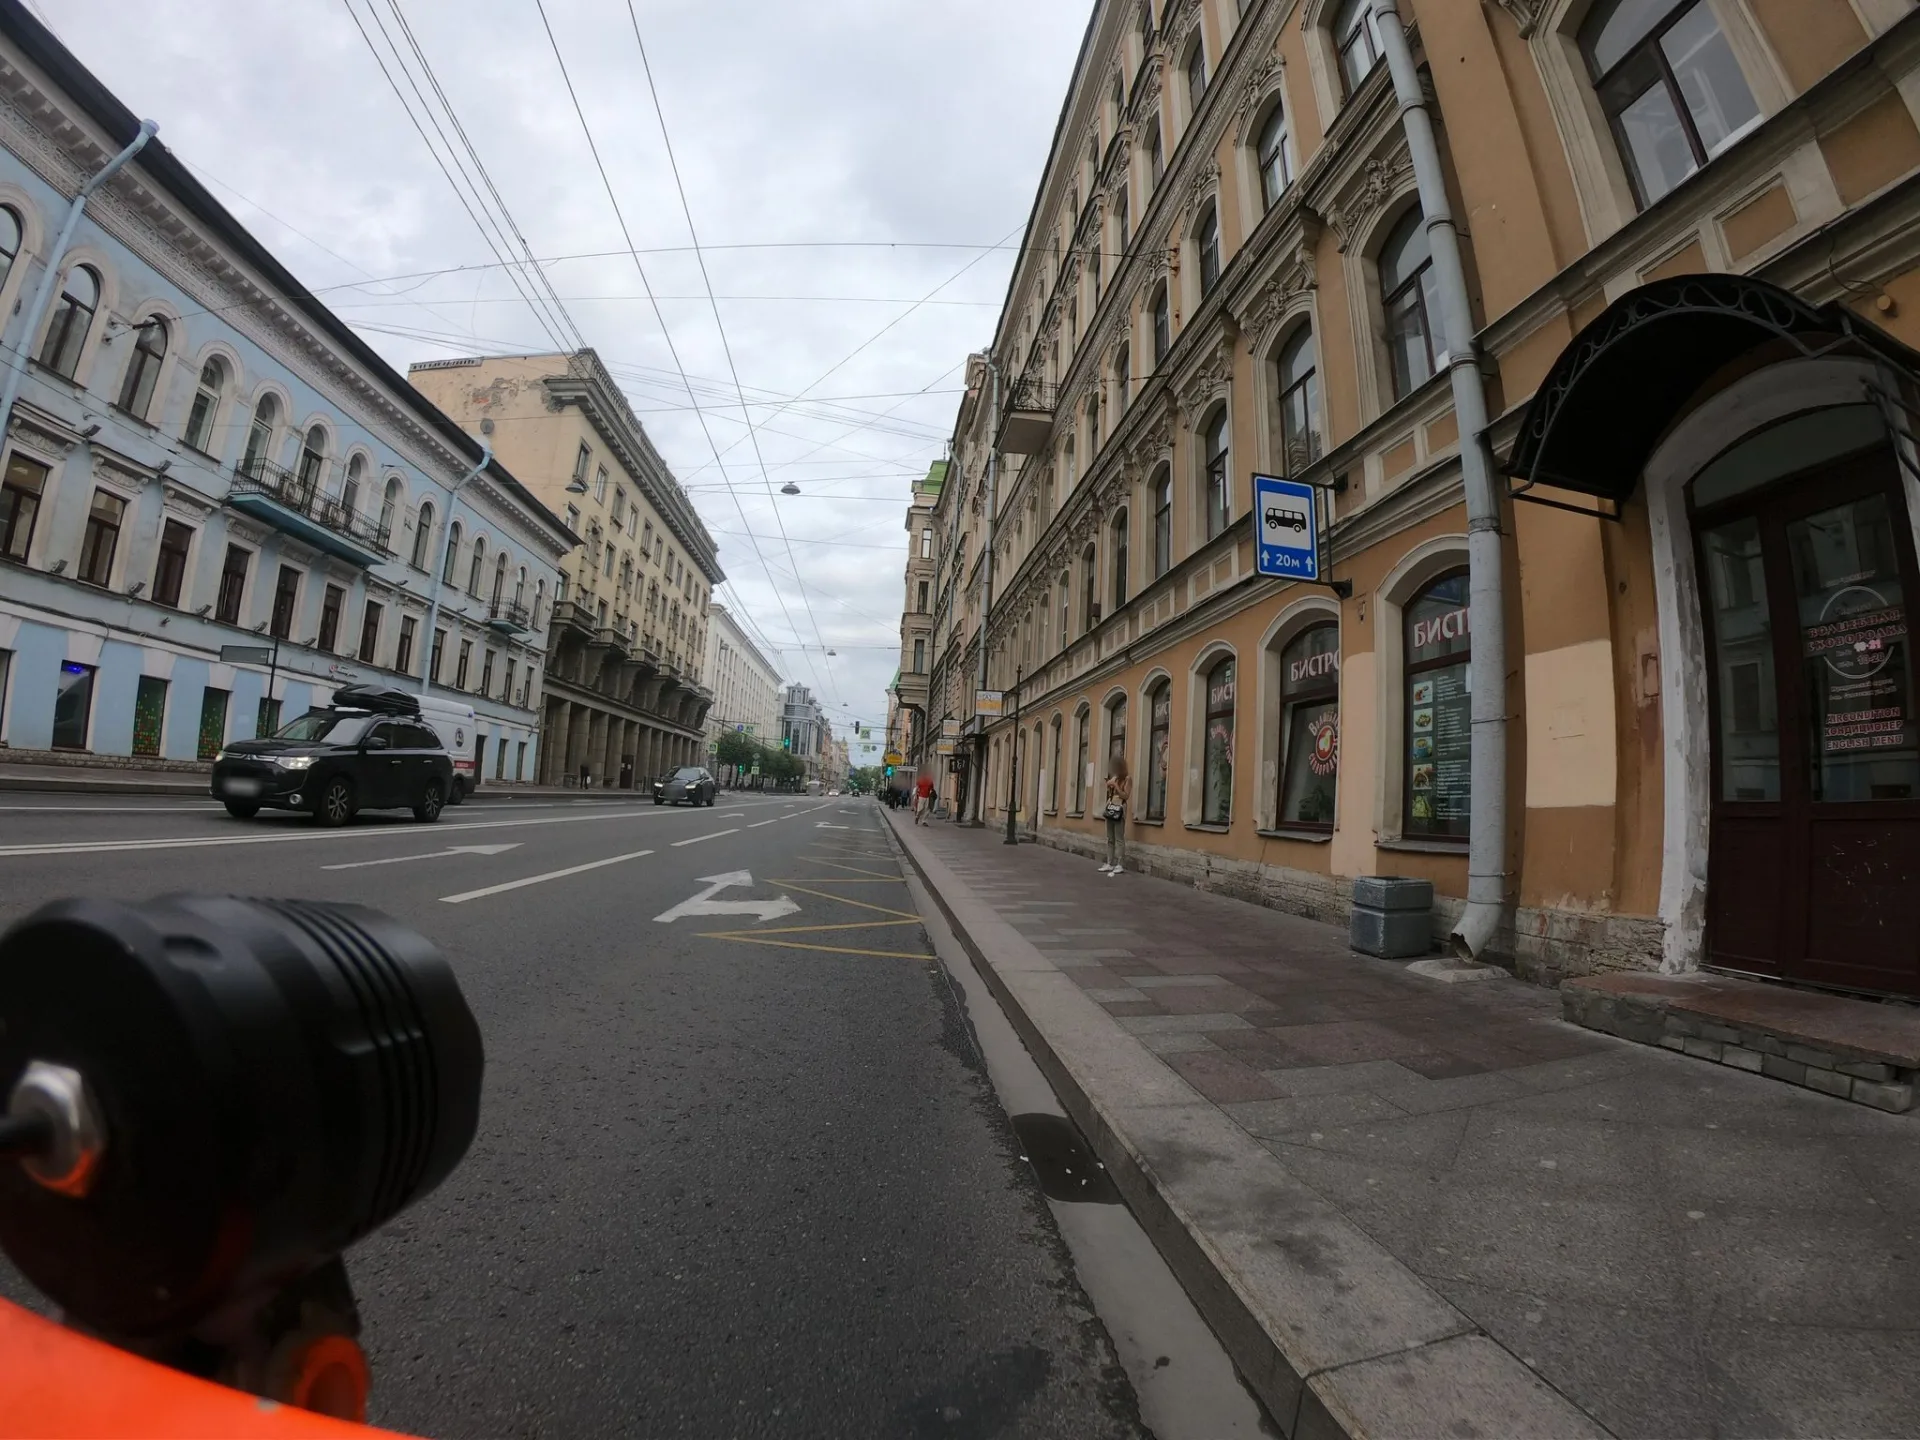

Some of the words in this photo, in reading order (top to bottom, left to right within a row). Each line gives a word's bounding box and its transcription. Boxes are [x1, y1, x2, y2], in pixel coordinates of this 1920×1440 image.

[1275, 553, 1300, 568] 20м
[1826, 707, 1901, 725] AIRCONDITION
[1825, 719, 1904, 737] КОНДИЦИОНЕР
[1825, 737, 1871, 750] ENGLISH
[1871, 734, 1904, 747] MENU
